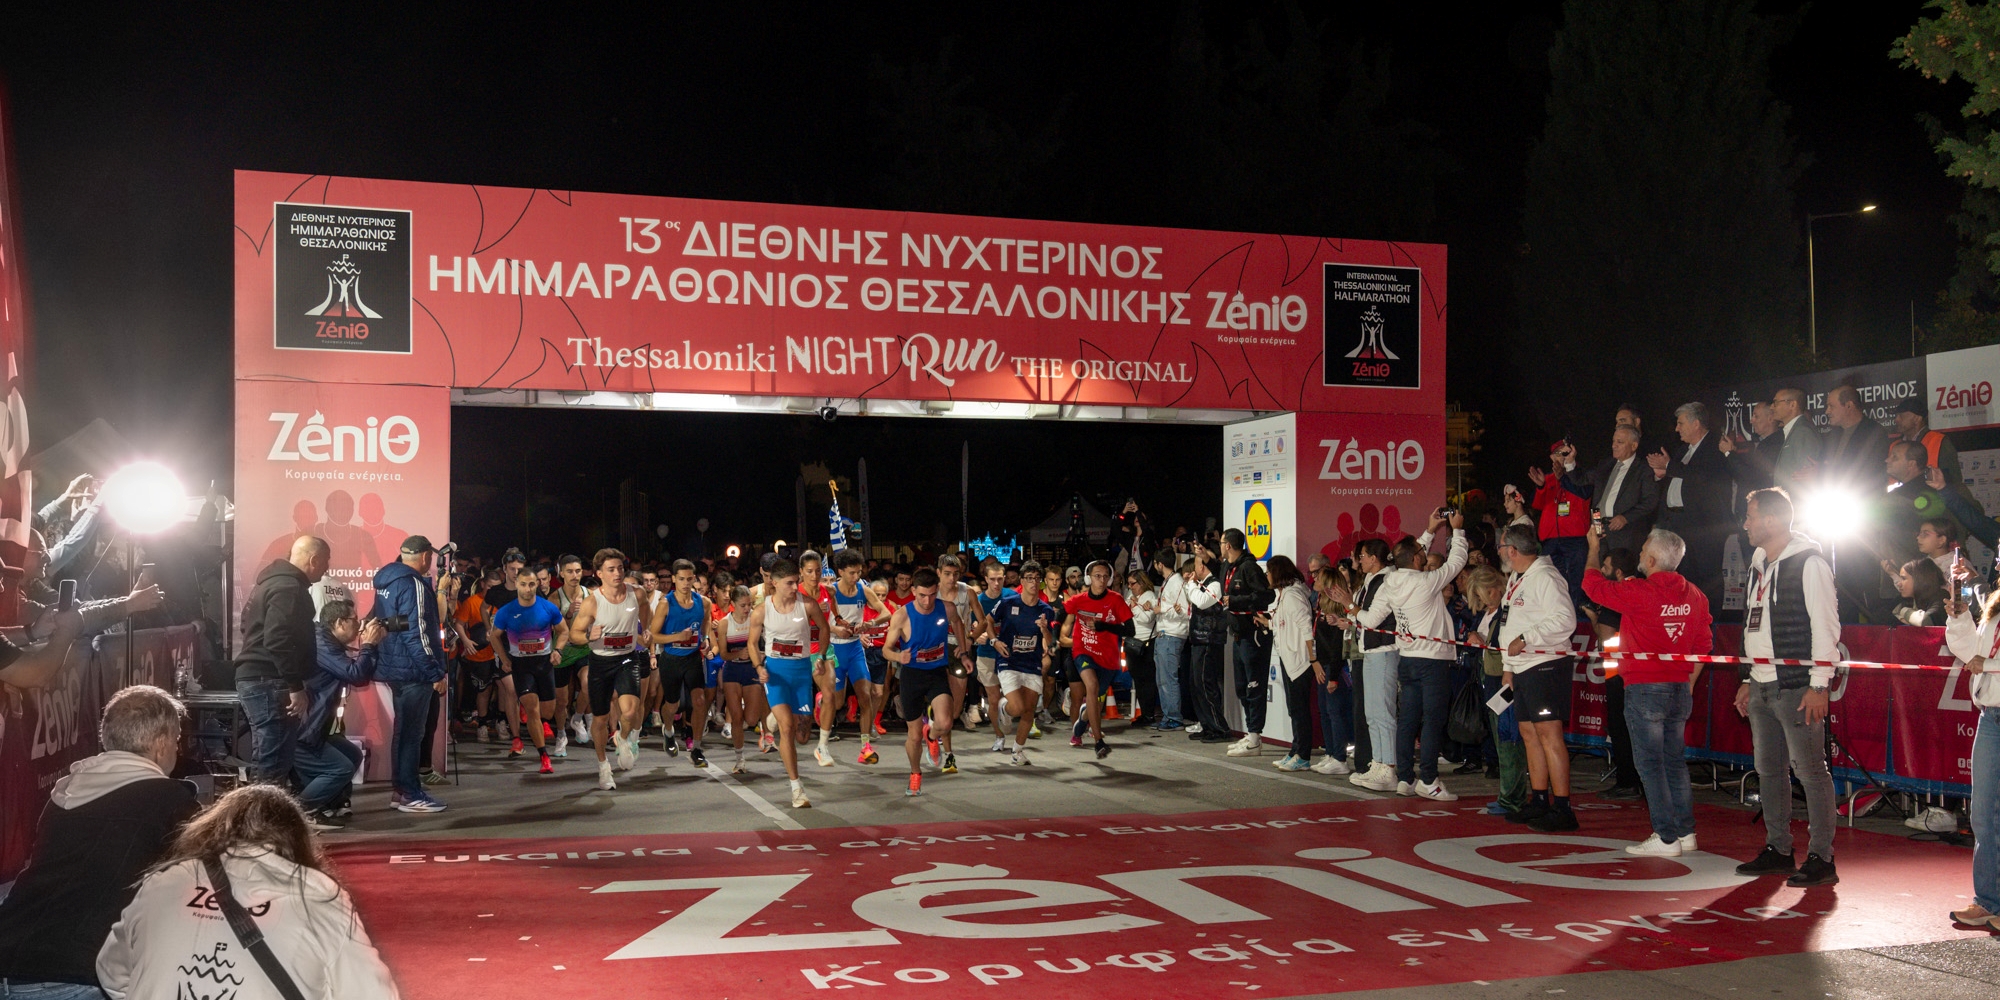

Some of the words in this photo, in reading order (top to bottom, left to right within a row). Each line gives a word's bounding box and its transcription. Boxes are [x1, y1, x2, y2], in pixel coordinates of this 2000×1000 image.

[291, 213, 335, 224] ΔΙΕΘΝΗΣ
[338, 216, 396, 227] ΝΥΧΤΕΡΙΝΟΣ
[290, 224, 396, 240] ΗΜΙΜΑΡΑΘΩΝΙΟΣ
[300, 238, 387, 252] ΘΕΣΣΑΛΟΝΙΚΗΣ
[682, 220, 888, 266] ΔΙΕΘΝΗΣ
[901, 232, 1163, 280] ΝΥΧΤΕΡΙΝΟΣ
[1346, 272, 1398, 281] INTERNATIONAL
[430, 255, 849, 310] ΗΜΙΜΑΡΑΘΩΝΙΟΣ
[861, 278, 1191, 325] ΘΕΣΣΑΛΟΝΙΚΗΣ
[1333, 281, 1387, 291] THESSALONIKI
[1388, 284, 1411, 293] NIGHT
[1334, 291, 1410, 303] HALFMARATHON
[567, 336, 777, 372] Thessaloniki
[786, 335, 895, 375] NIGHT
[901, 333, 1005, 387] Run
[1011, 356, 1064, 379] THE
[1071, 359, 1193, 383] ORIGINAL
[285, 469, 344, 481] Κορυφαία
[328, 567, 362, 578] υσικό
[390, 848, 692, 864] Ευκαιρία
[715, 841, 817, 855] για
[1102, 815, 1358, 835] Ευκαιρία
[1368, 808, 1459, 823] για
[800, 937, 1356, 990] Κορυφαία
